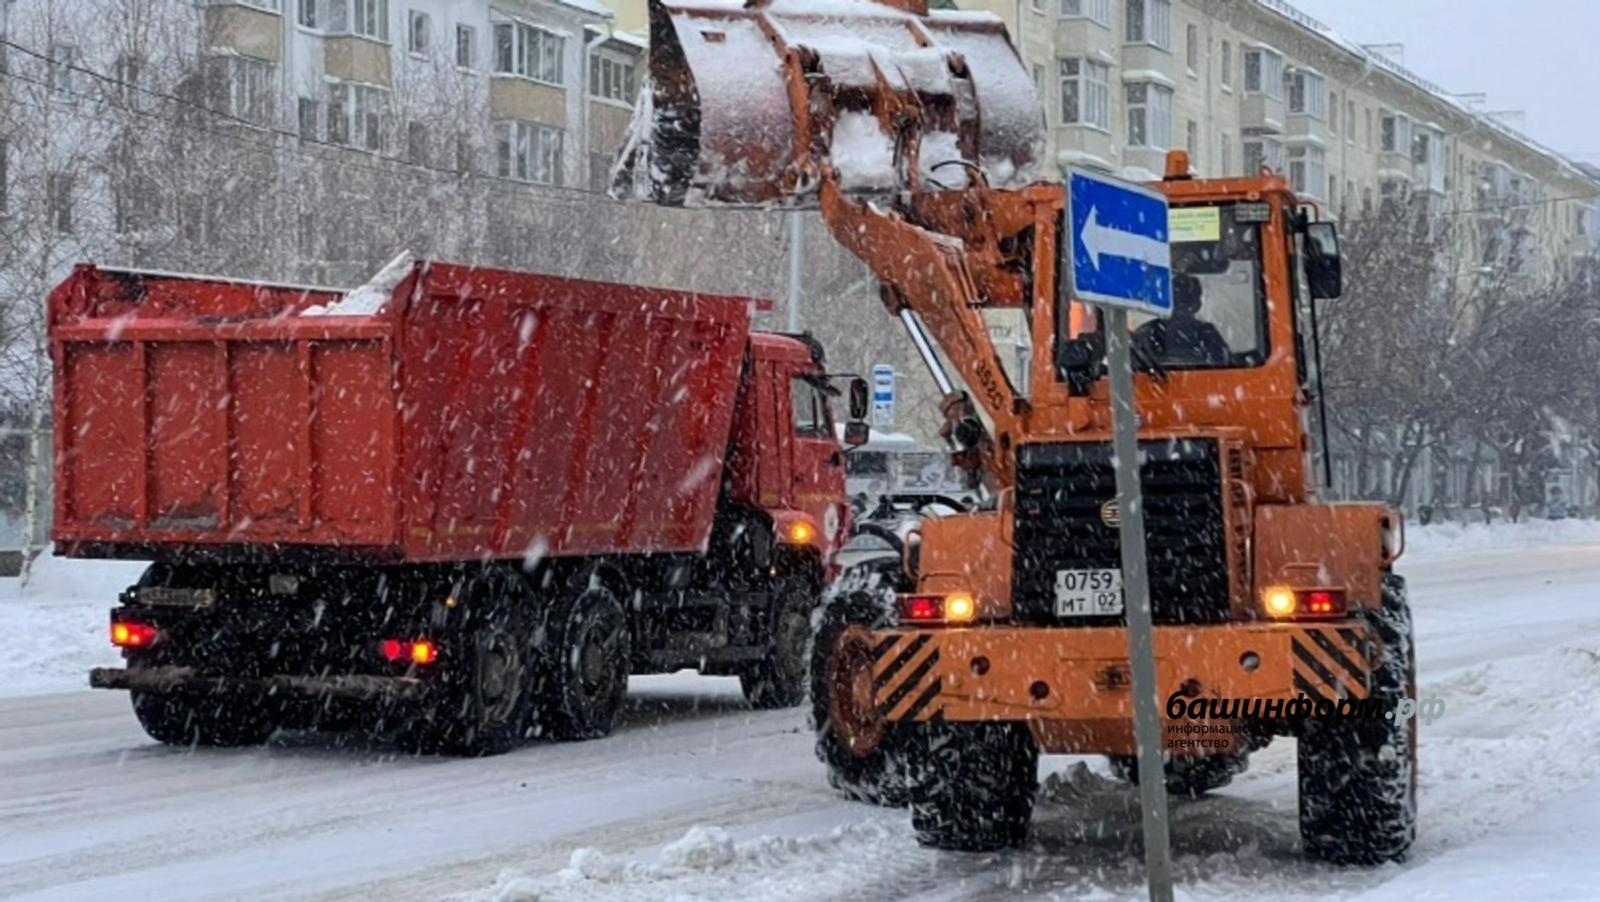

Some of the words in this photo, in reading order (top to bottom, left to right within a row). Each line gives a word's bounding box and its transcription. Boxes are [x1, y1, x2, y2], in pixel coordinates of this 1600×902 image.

[1064, 571, 1113, 591] 0759
[1062, 598, 1086, 612] МТ
[1098, 592, 1116, 606] 02
